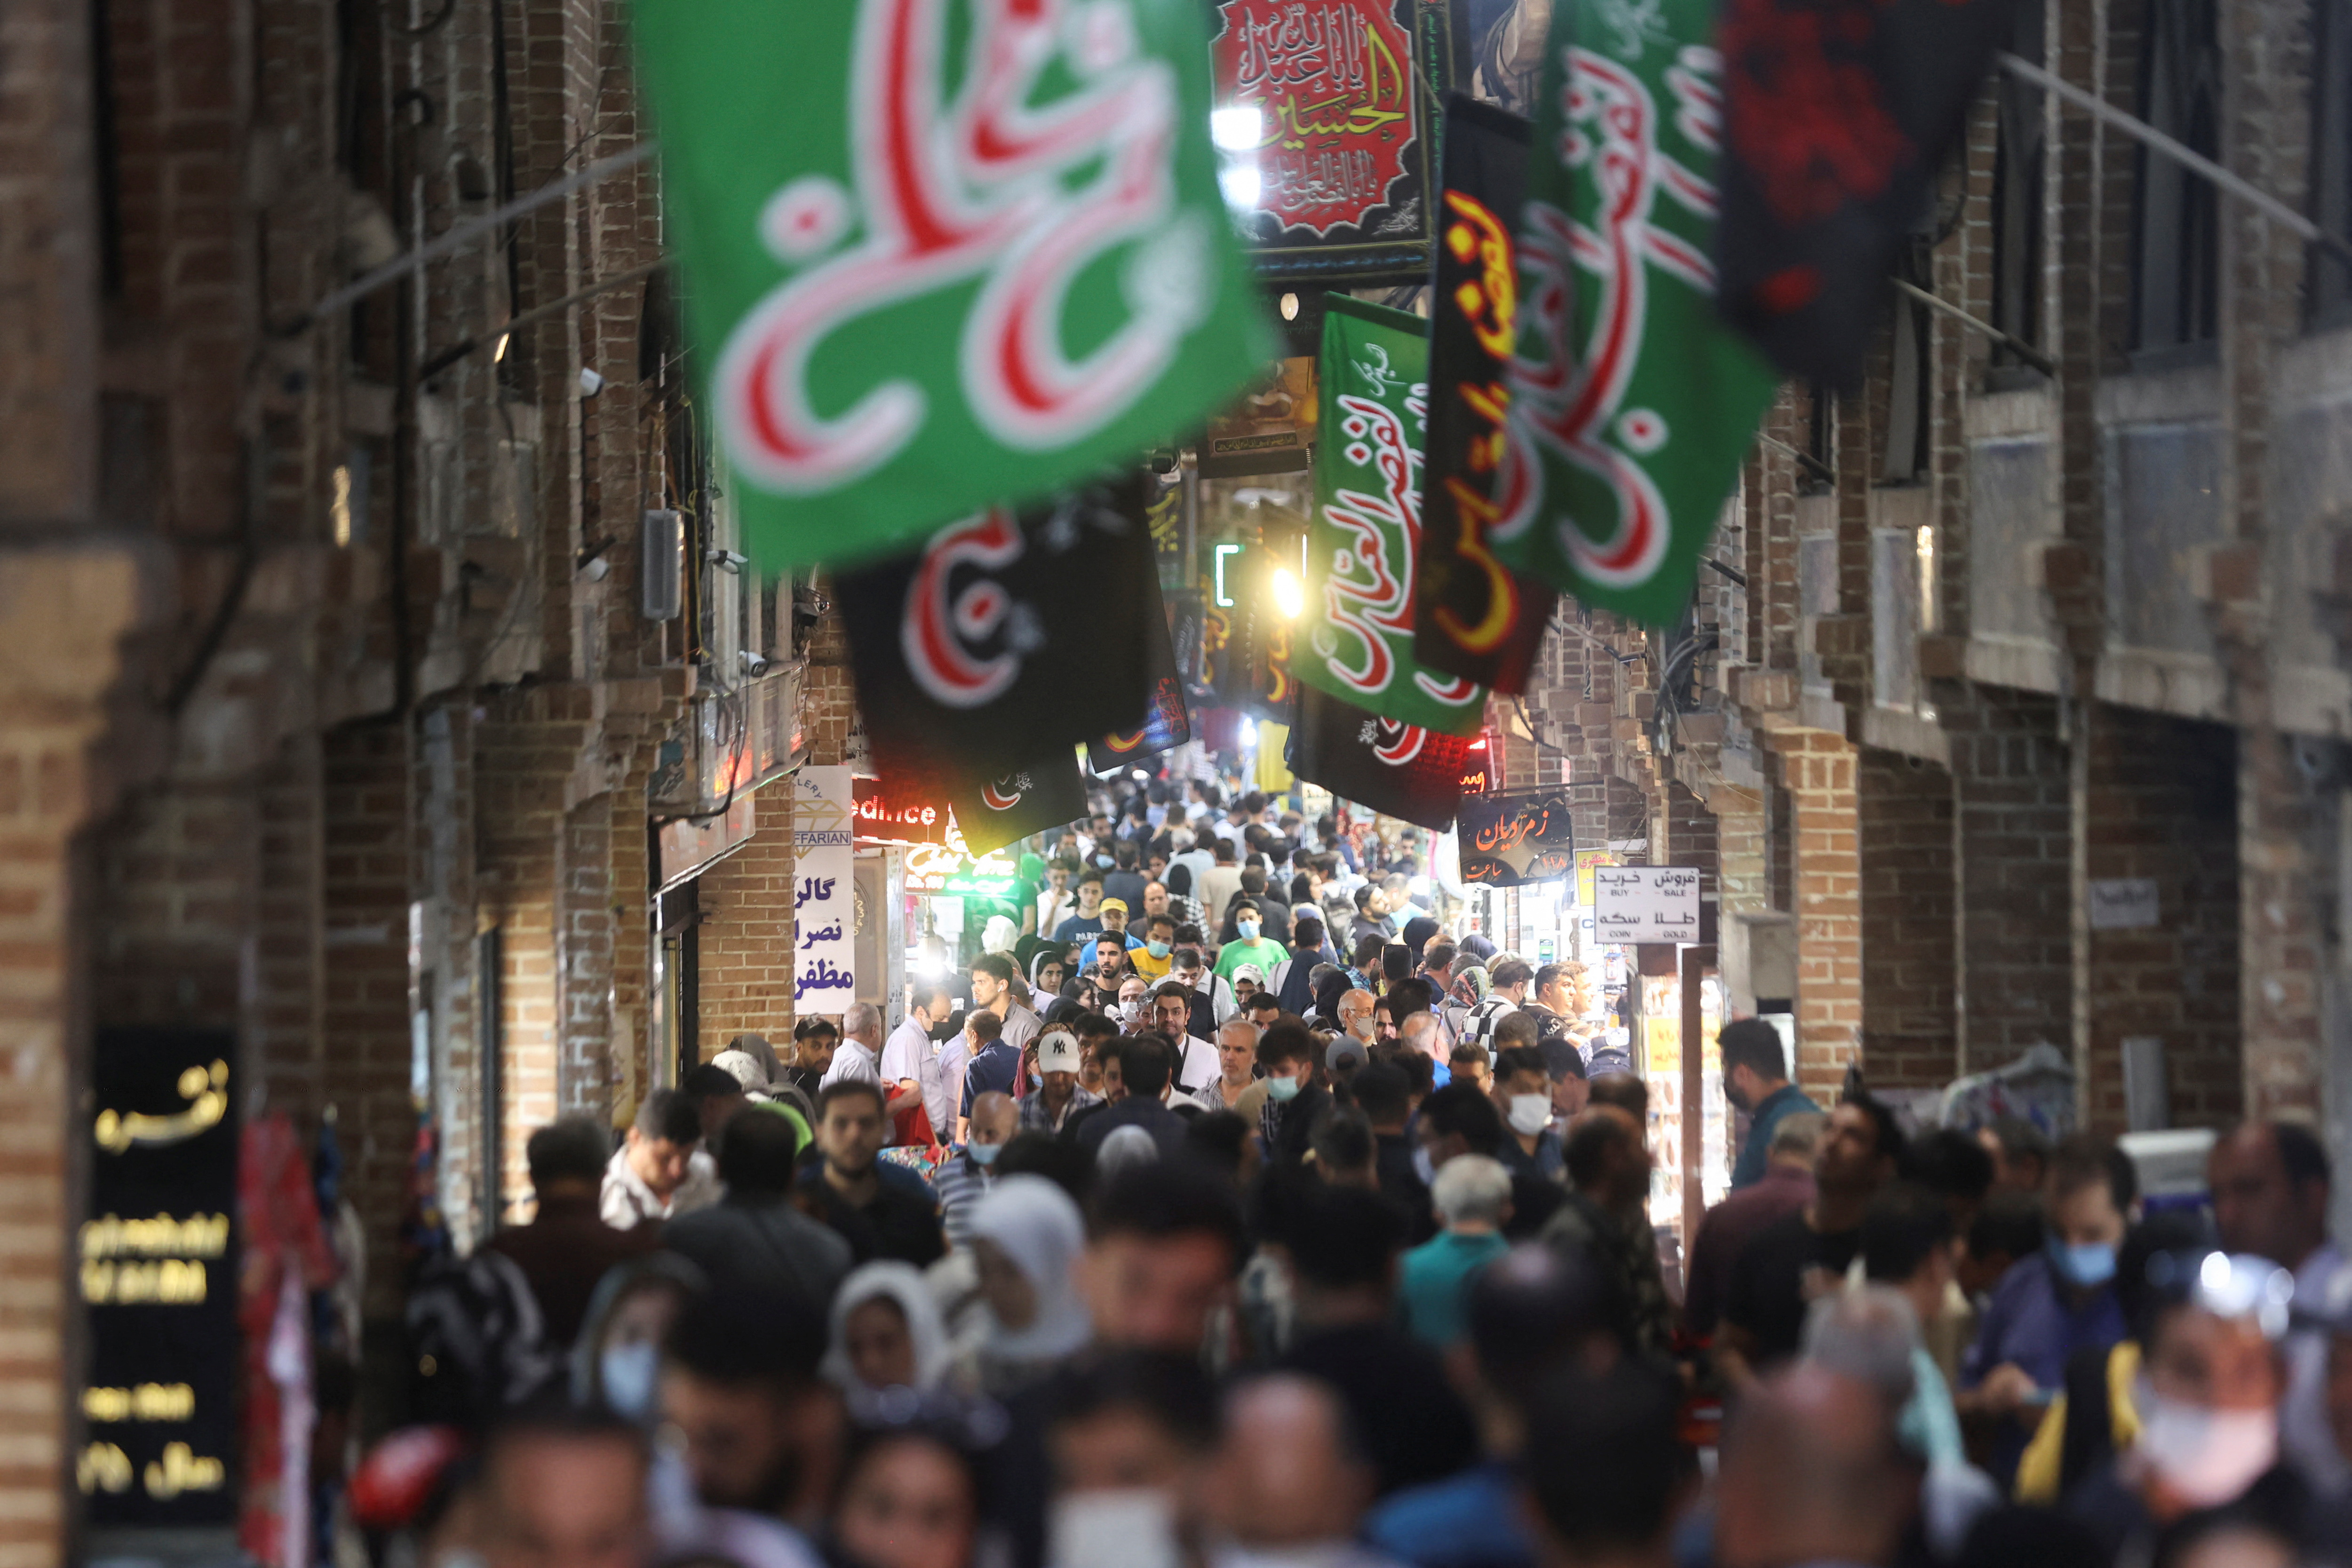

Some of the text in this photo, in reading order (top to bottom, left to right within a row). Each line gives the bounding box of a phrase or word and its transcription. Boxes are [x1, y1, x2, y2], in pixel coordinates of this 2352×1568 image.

[1599, 870, 1696, 887] خرید فروش
[1600, 912, 1696, 924] سکه طلا
